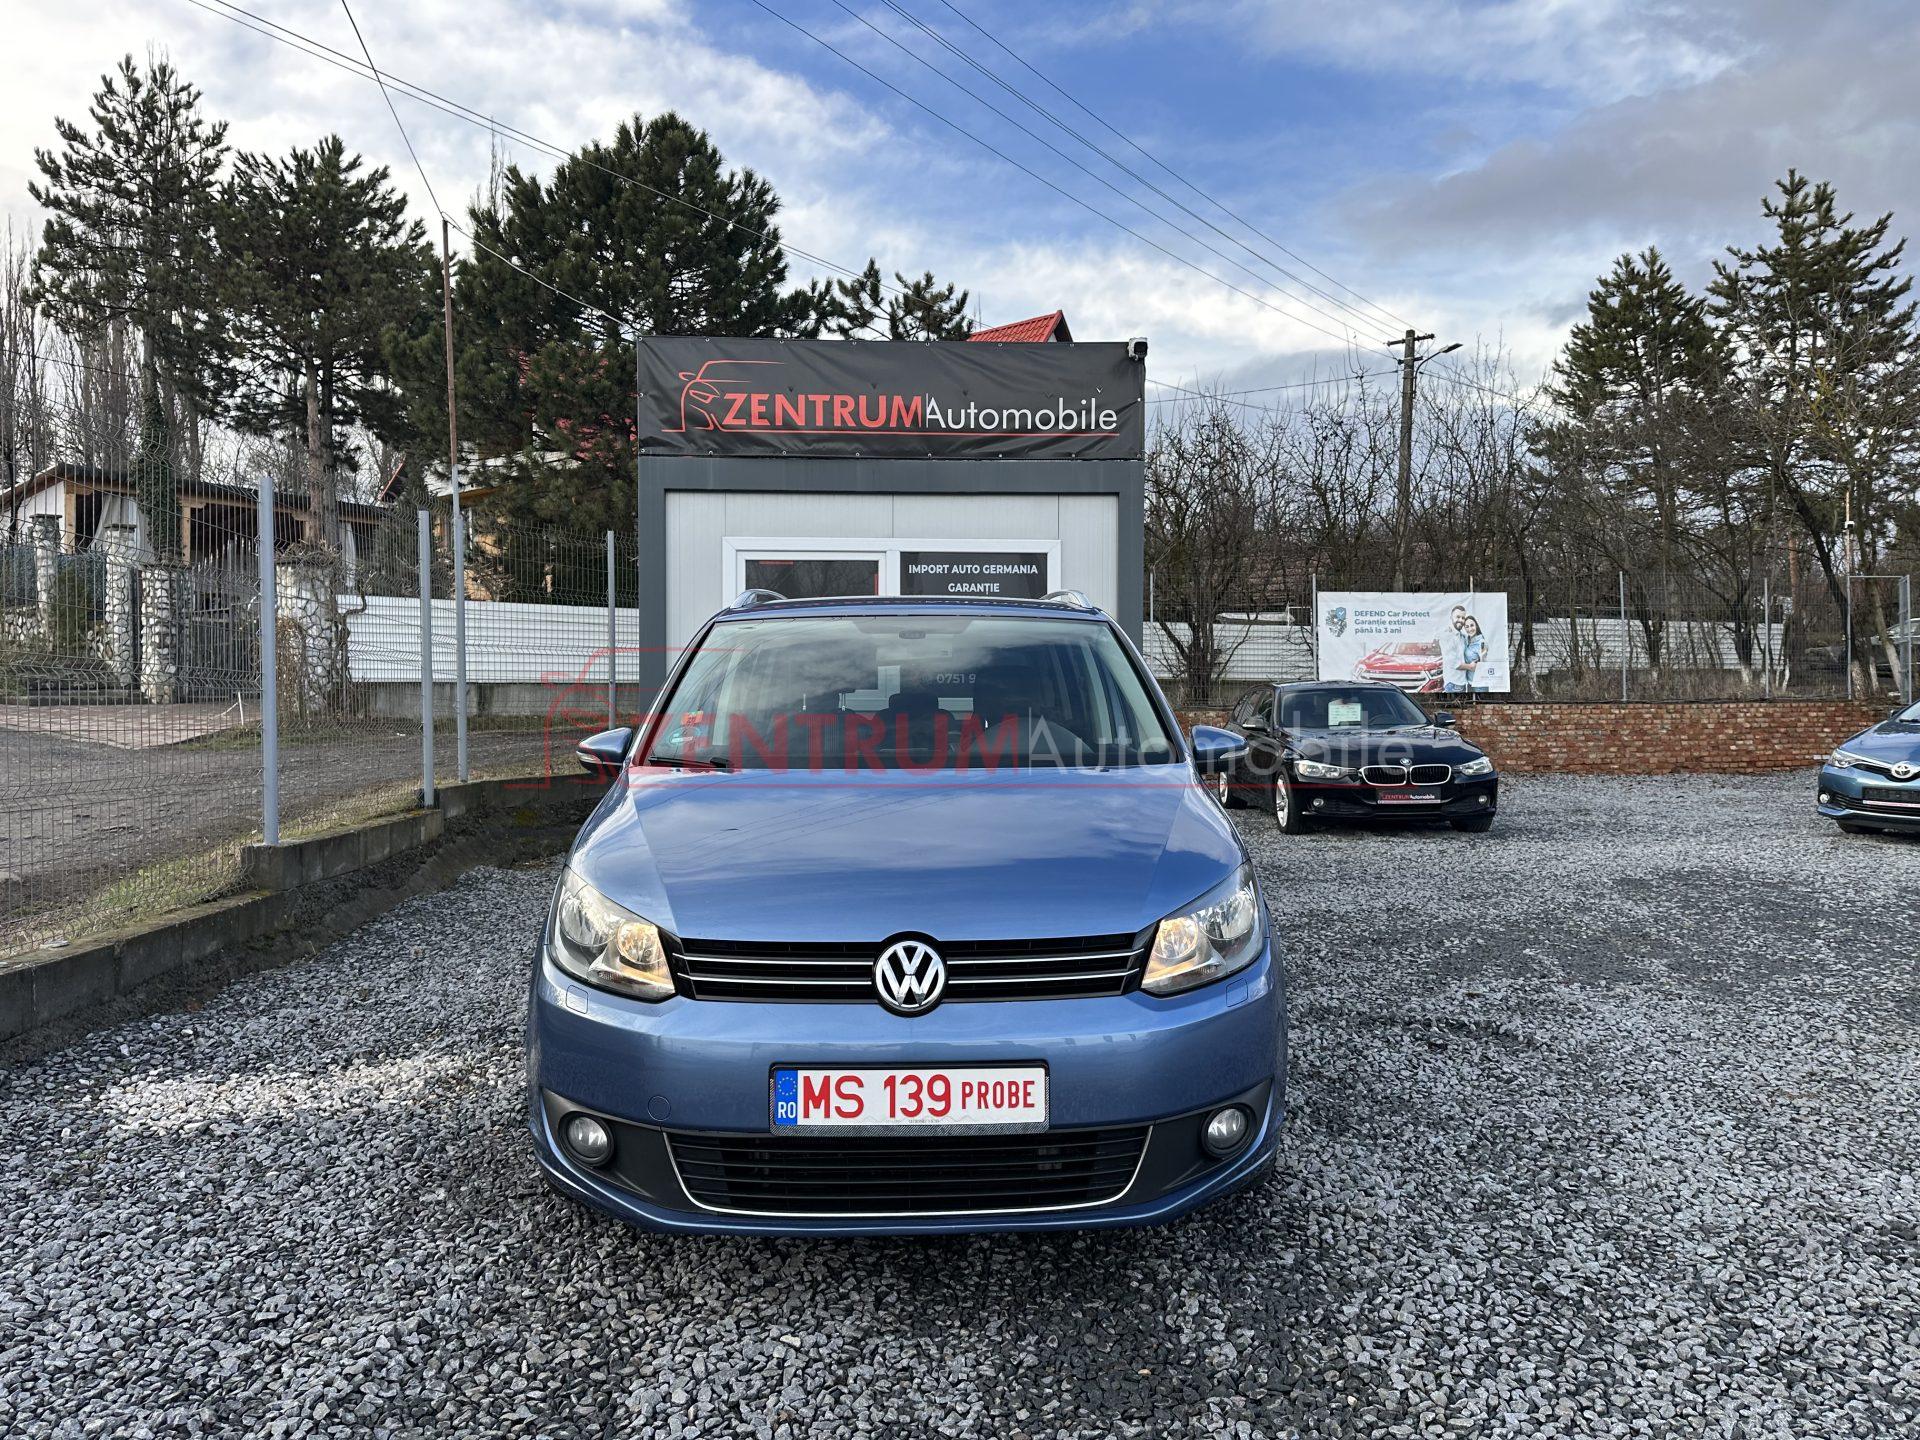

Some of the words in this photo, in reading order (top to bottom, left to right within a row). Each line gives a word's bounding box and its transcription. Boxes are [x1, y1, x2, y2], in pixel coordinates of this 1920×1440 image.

[722, 393, 922, 428] ZENTRUM
[926, 397, 1118, 430] Automobile
[908, 564, 949, 574] IMPORT
[951, 564, 980, 574] AUTO
[982, 564, 1038, 574] GERMANIA
[778, 1102, 796, 1118] RO
[803, 1075, 864, 1118] MS
[884, 1074, 950, 1117] 139
[962, 1081, 1035, 1109] PROBE
